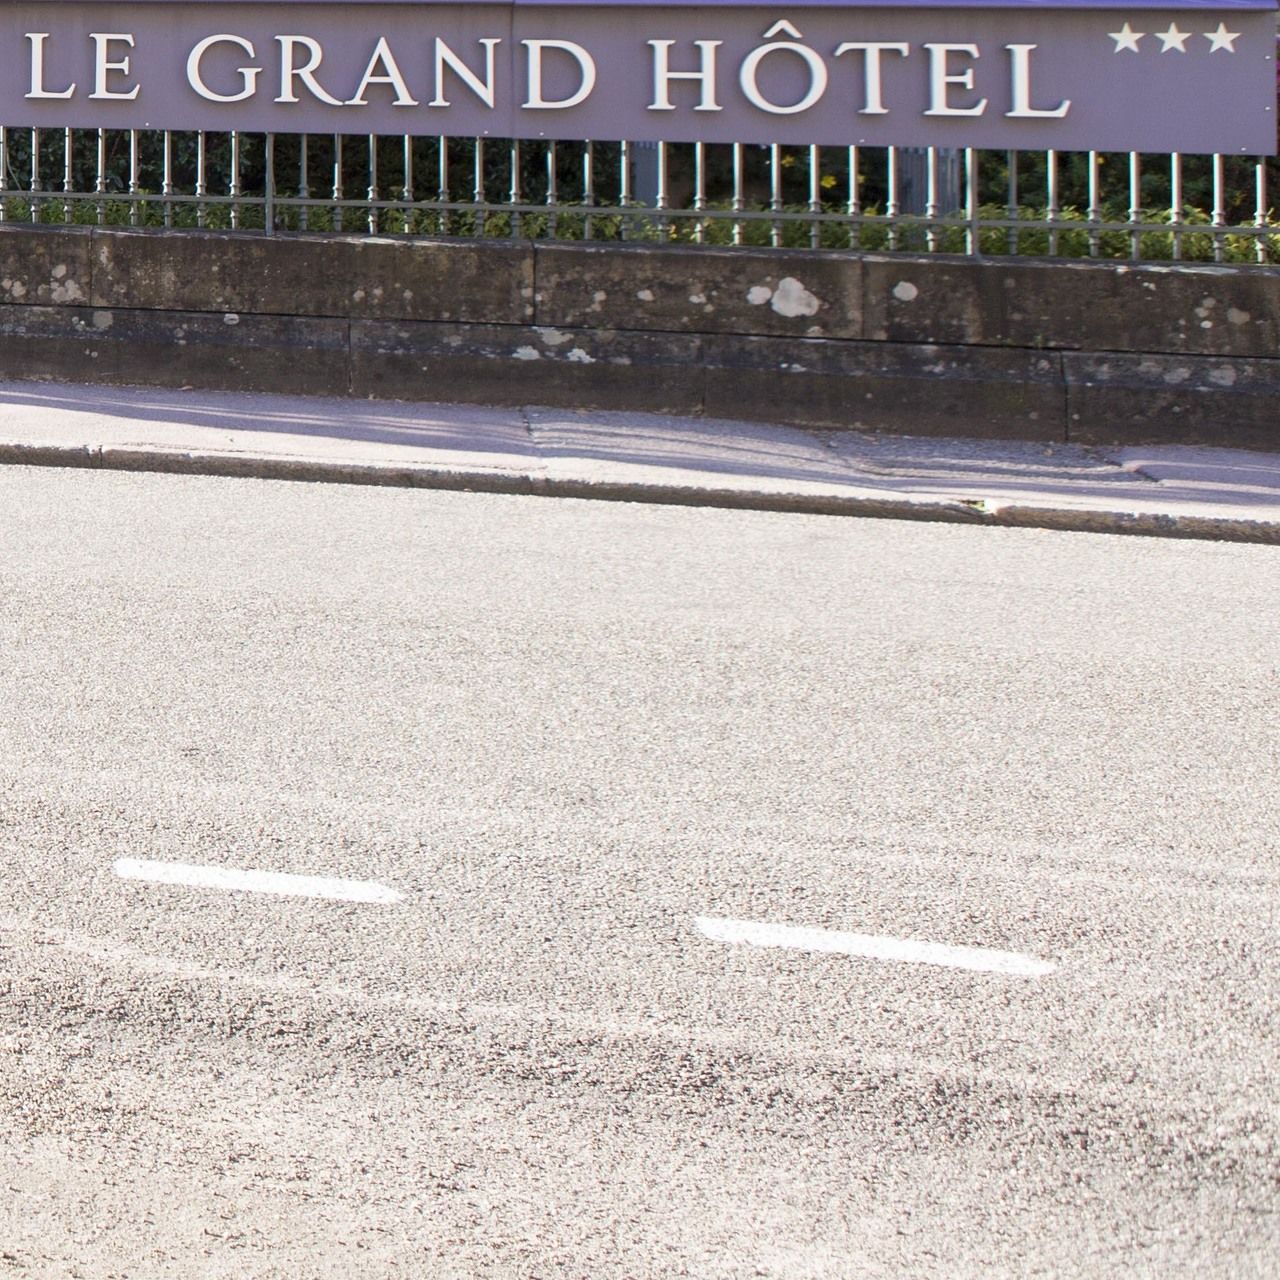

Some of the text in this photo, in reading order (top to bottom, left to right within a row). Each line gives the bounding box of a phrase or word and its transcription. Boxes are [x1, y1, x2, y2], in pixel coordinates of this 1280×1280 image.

[24, 19, 1071, 119] LE GRAND HÔTEL
